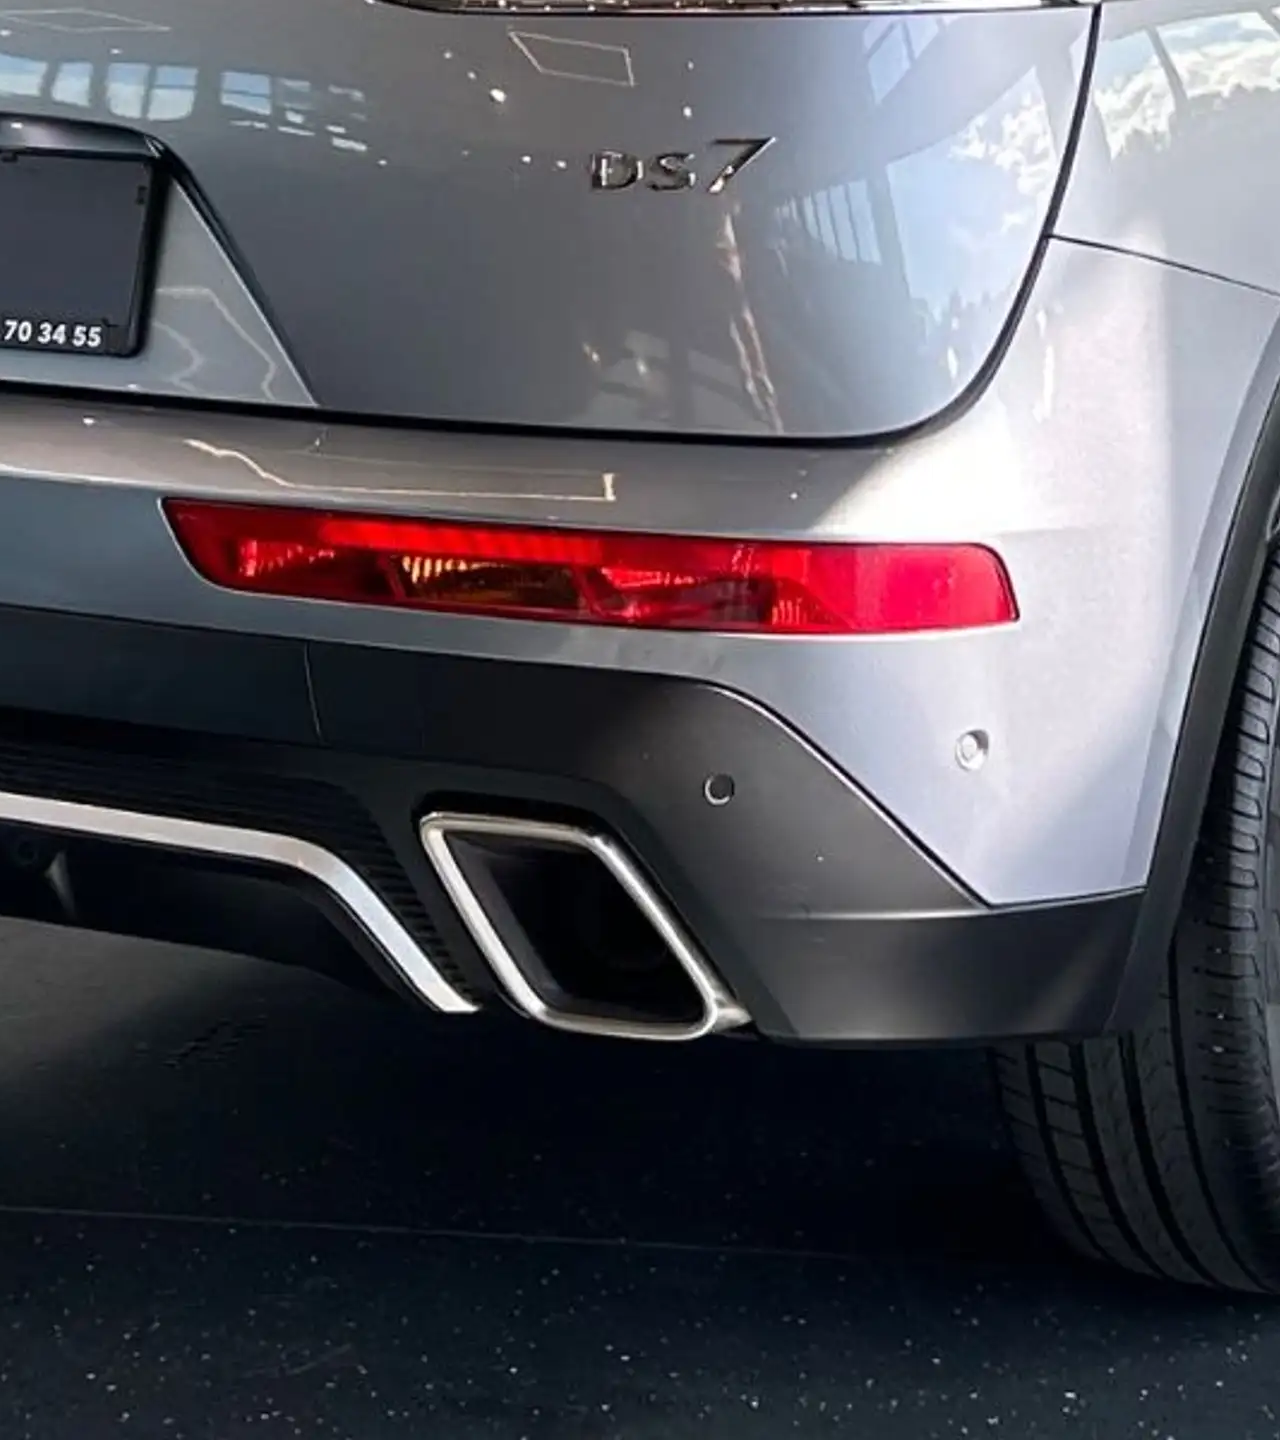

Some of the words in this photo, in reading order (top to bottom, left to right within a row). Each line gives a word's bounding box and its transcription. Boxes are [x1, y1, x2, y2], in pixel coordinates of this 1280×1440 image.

[4, 319, 33, 343] 70
[37, 322, 67, 345] 34
[72, 325, 103, 348] 55
